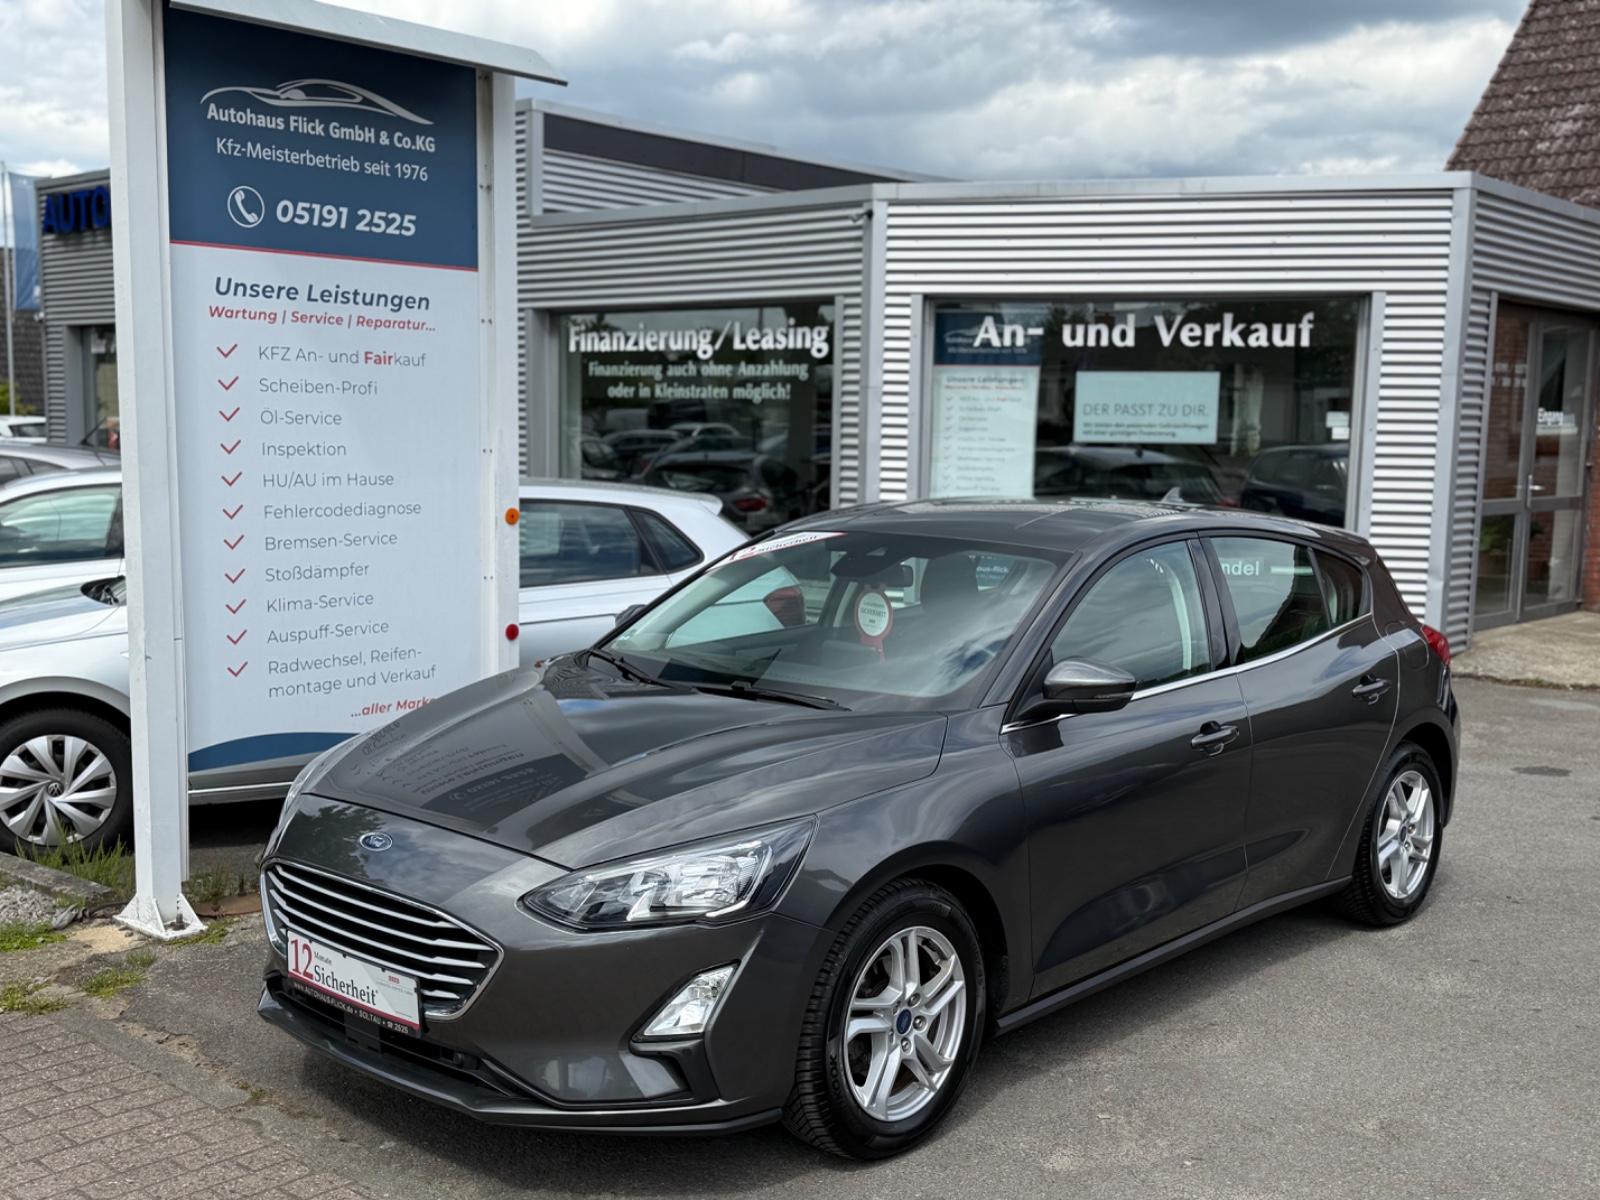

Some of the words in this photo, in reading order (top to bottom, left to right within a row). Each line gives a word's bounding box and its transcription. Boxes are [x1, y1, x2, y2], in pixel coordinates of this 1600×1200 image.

[207, 103, 285, 130] Autohaus
[289, 115, 324, 136] Flick
[329, 121, 375, 145] GmbH
[379, 130, 389, 146] &
[393, 131, 436, 152] Co.KG
[216, 137, 360, 173] Kfz-Meisterbetrieb
[364, 161, 391, 177] seit
[395, 163, 428, 181] 1976
[43, 187, 110, 232] AUTO
[276, 199, 348, 230] 05191
[356, 209, 417, 237] 2525
[214, 276, 299, 301] Unsere
[306, 284, 430, 312] Leistungen
[208, 305, 277, 324] Wartung
[290, 311, 344, 326] Service
[973, 315, 1044, 347] An-
[1062, 313, 1136, 347] und
[1154, 312, 1315, 347] Verkauf
[258, 346, 291, 361] KFZ
[295, 349, 323, 363] An-
[328, 350, 360, 364] und
[364, 351, 426, 368] Fairkauf
[588, 362, 663, 381] Finanzierung
[666, 362, 697, 377] auch
[700, 361, 733, 376] ohne
[737, 360, 809, 381] Anzahlung
[259, 377, 378, 396] Scheiben-Profi
[608, 384, 635, 399] oder
[639, 384, 650, 399] in
[654, 383, 729, 399] Kleinstraten
[733, 383, 791, 404] möglich!
[260, 408, 342, 426] Öl-Service
[1083, 403, 1110, 417] DER
[1114, 402, 1153, 417] PASST
[1157, 402, 1178, 417] ZU
[261, 441, 347, 459] Inspektion
[263, 472, 317, 489] HU/AU
[322, 473, 342, 487] im
[347, 472, 394, 487] Hause
[263, 503, 422, 520] Fehlercodediagnose
[264, 531, 398, 551] Bremsen-Service
[265, 562, 370, 583] Stoßdämpfer
[266, 592, 374, 613] Klima-Service
[266, 621, 389, 644] Auspuff-Service
[268, 653, 367, 675] Radwechsel,
[370, 646, 422, 665] Reifen-
[269, 677, 342, 698] montage
[346, 672, 376, 689] und
[380, 665, 437, 685] Verkauf
[290, 938, 314, 981] 12
